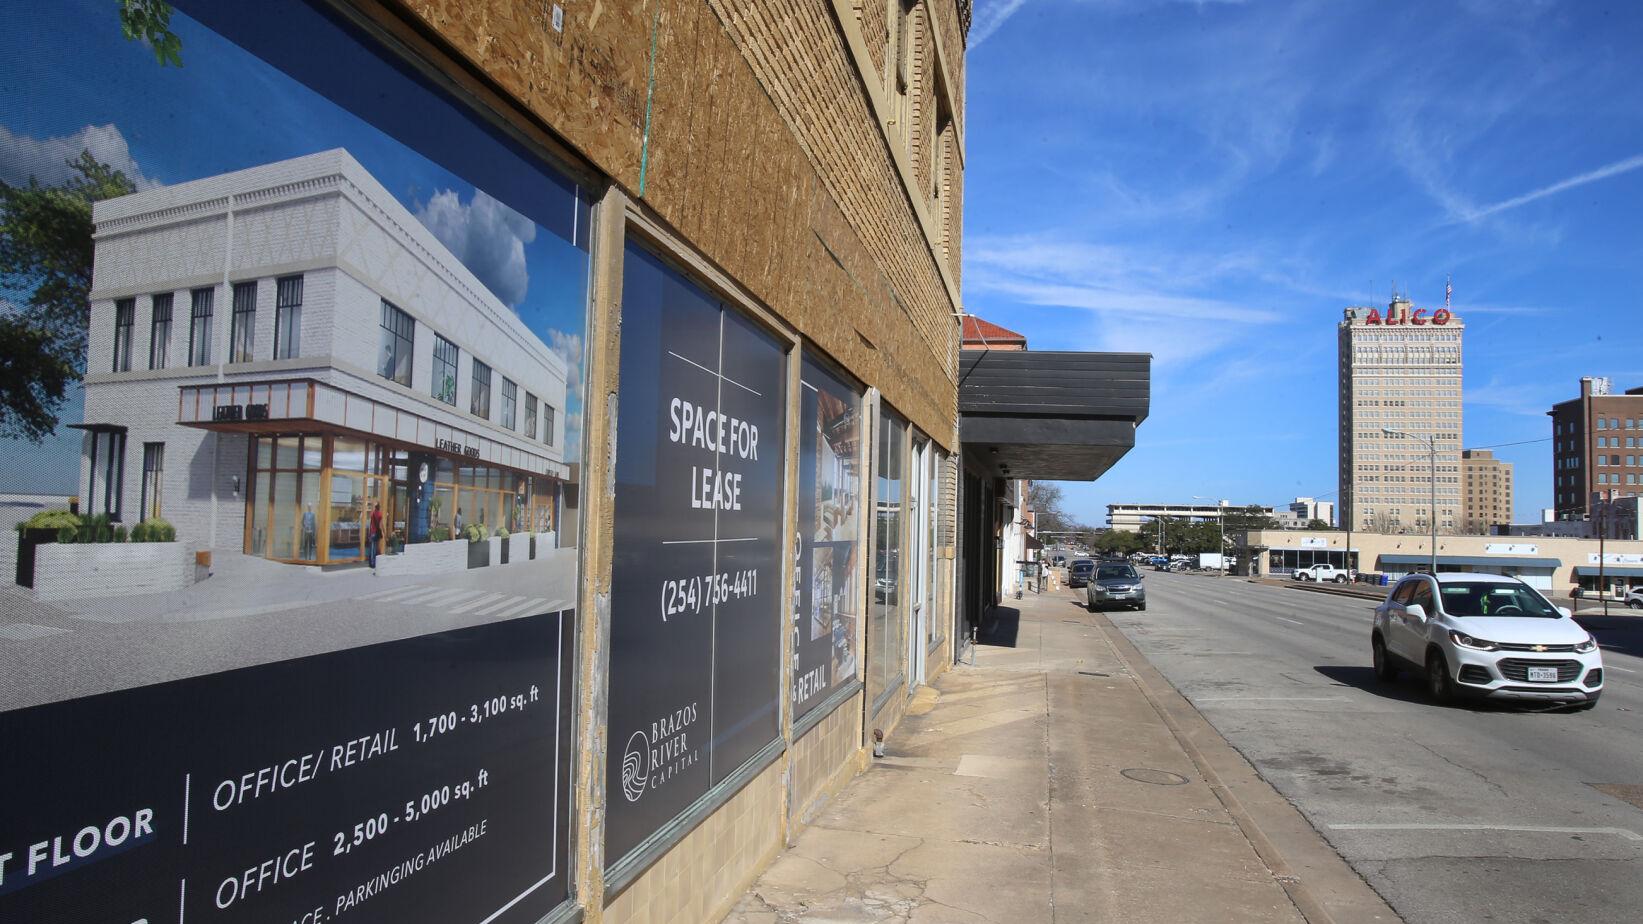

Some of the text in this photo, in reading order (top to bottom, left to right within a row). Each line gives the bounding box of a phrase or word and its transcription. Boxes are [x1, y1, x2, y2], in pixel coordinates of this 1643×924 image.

[1366, 308, 1451, 325] ALICO
[669, 397, 759, 461] SPACE FOR
[691, 466, 742, 511] LEASE
[661, 569, 757, 622] (254) 756-4411
[798, 664, 827, 705] RETAIL
[651, 702, 697, 744] BRAZOS
[213, 750, 324, 811] OFFICE/
[330, 728, 399, 772] RETAIL
[413, 711, 457, 743] 1,700
[470, 695, 507, 724] 3,100
[510, 693, 527, 710] sq.
[529, 685, 539, 701] ft
[651, 733, 687, 772] RIVER
[651, 750, 698, 789] CAPITAL
[28, 808, 153, 876] FLOOR
[215, 841, 316, 910] OFFICE
[333, 813, 389, 857] 2,500
[404, 785, 450, 824] 5,000
[454, 778, 475, 800] sq.
[477, 768, 489, 787] ft
[335, 853, 424, 916] PARKINGING
[426, 819, 488, 866] AVAILABLE
